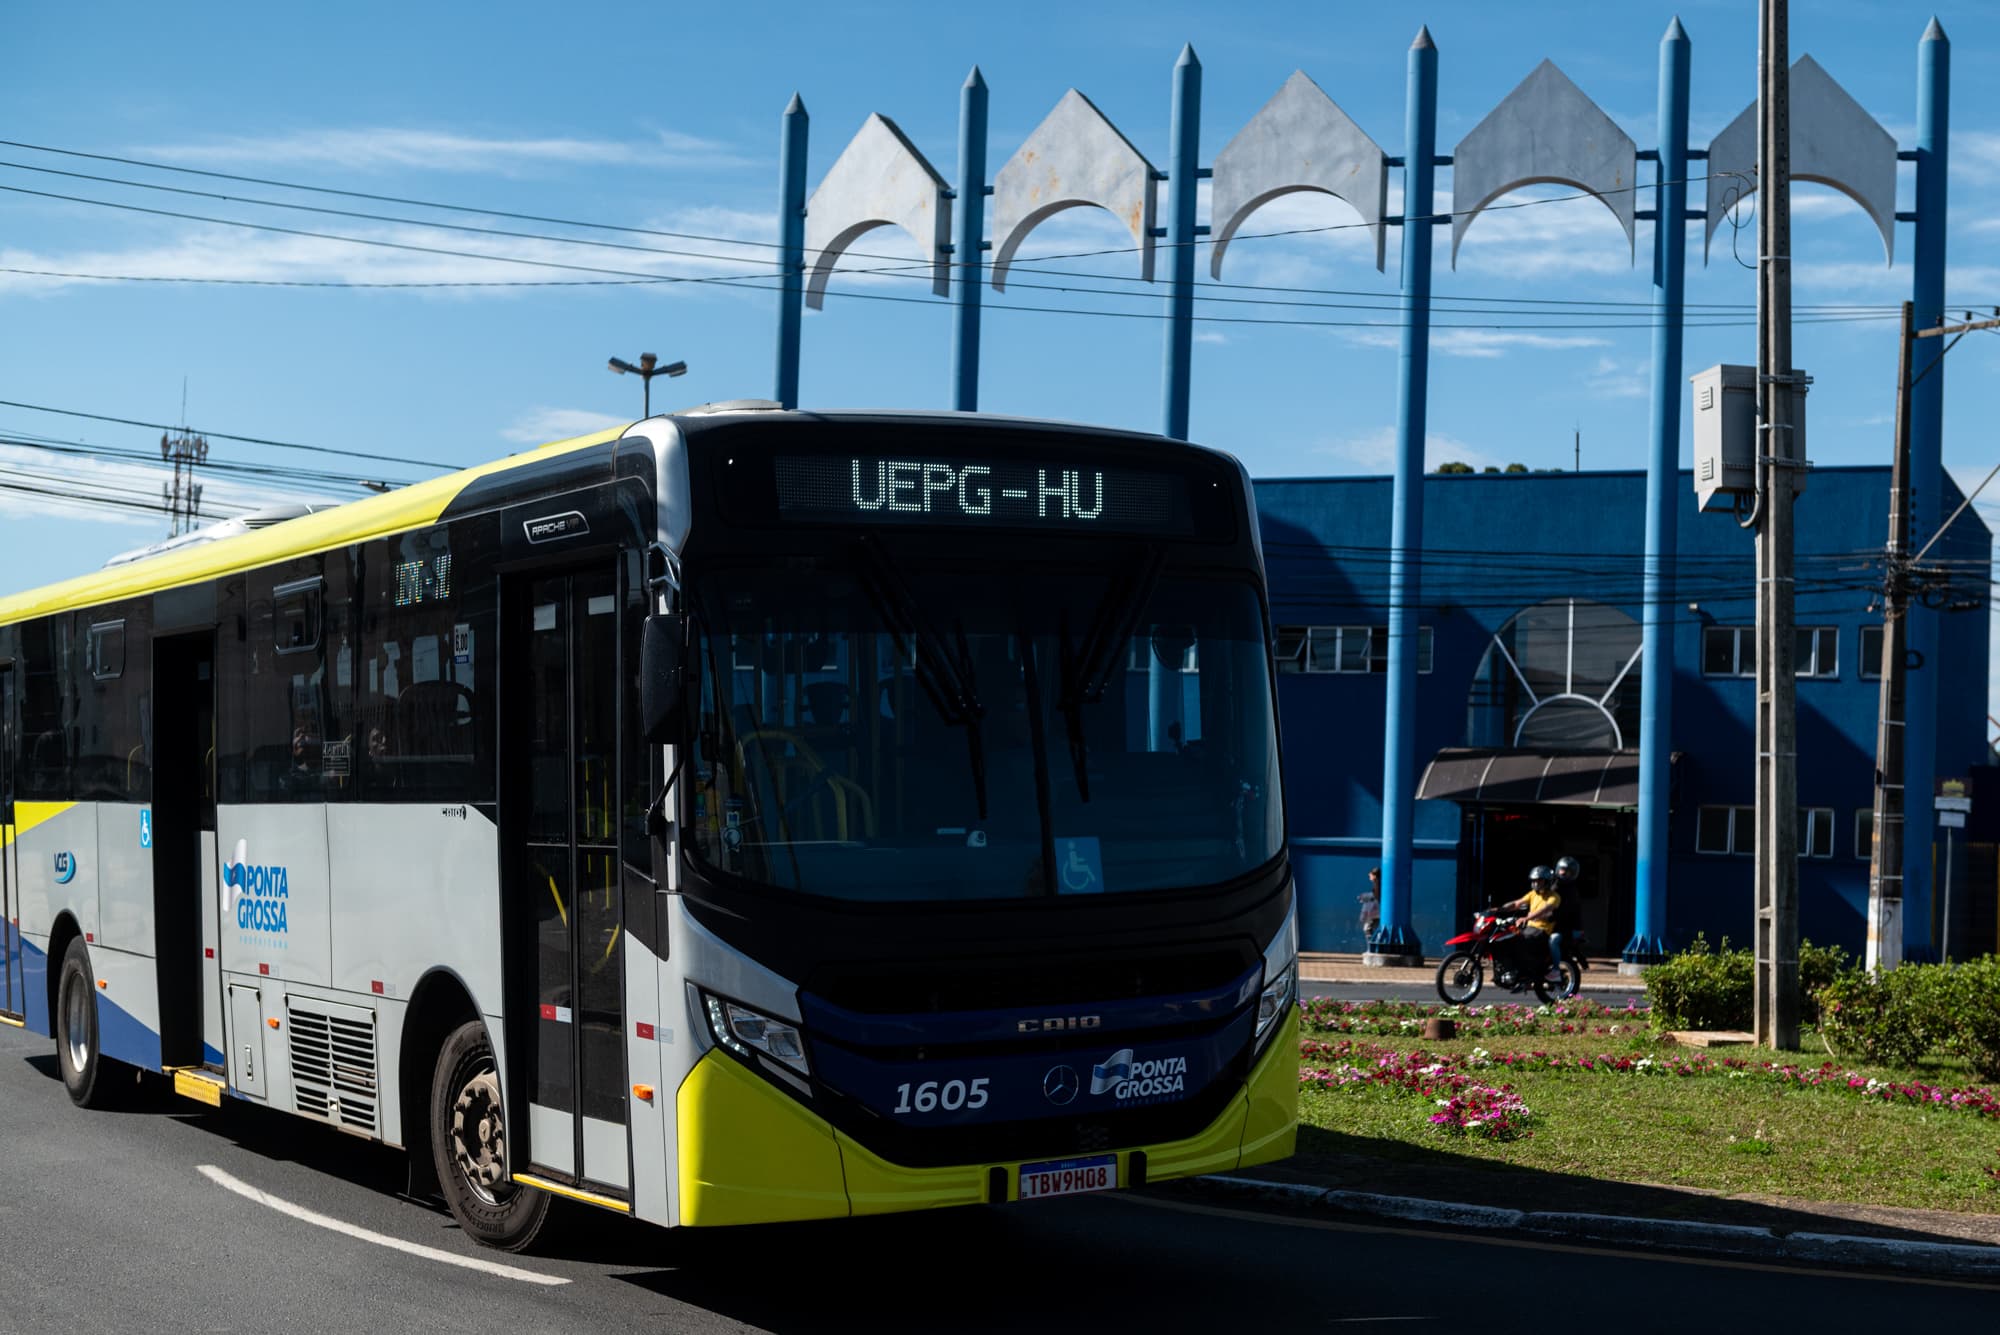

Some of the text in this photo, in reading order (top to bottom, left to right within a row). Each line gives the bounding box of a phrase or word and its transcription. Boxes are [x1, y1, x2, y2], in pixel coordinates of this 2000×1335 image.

[532, 520, 566, 536] APACHE
[246, 865, 289, 899] PONTA
[237, 898, 288, 934] GROSSA
[1017, 1015, 1101, 1033] CAIO
[1130, 1056, 1187, 1080] PONTA
[893, 1078, 990, 1114] 1605
[1115, 1075, 1184, 1100] GROSSA
[1028, 1167, 1107, 1196] TBW9H08
